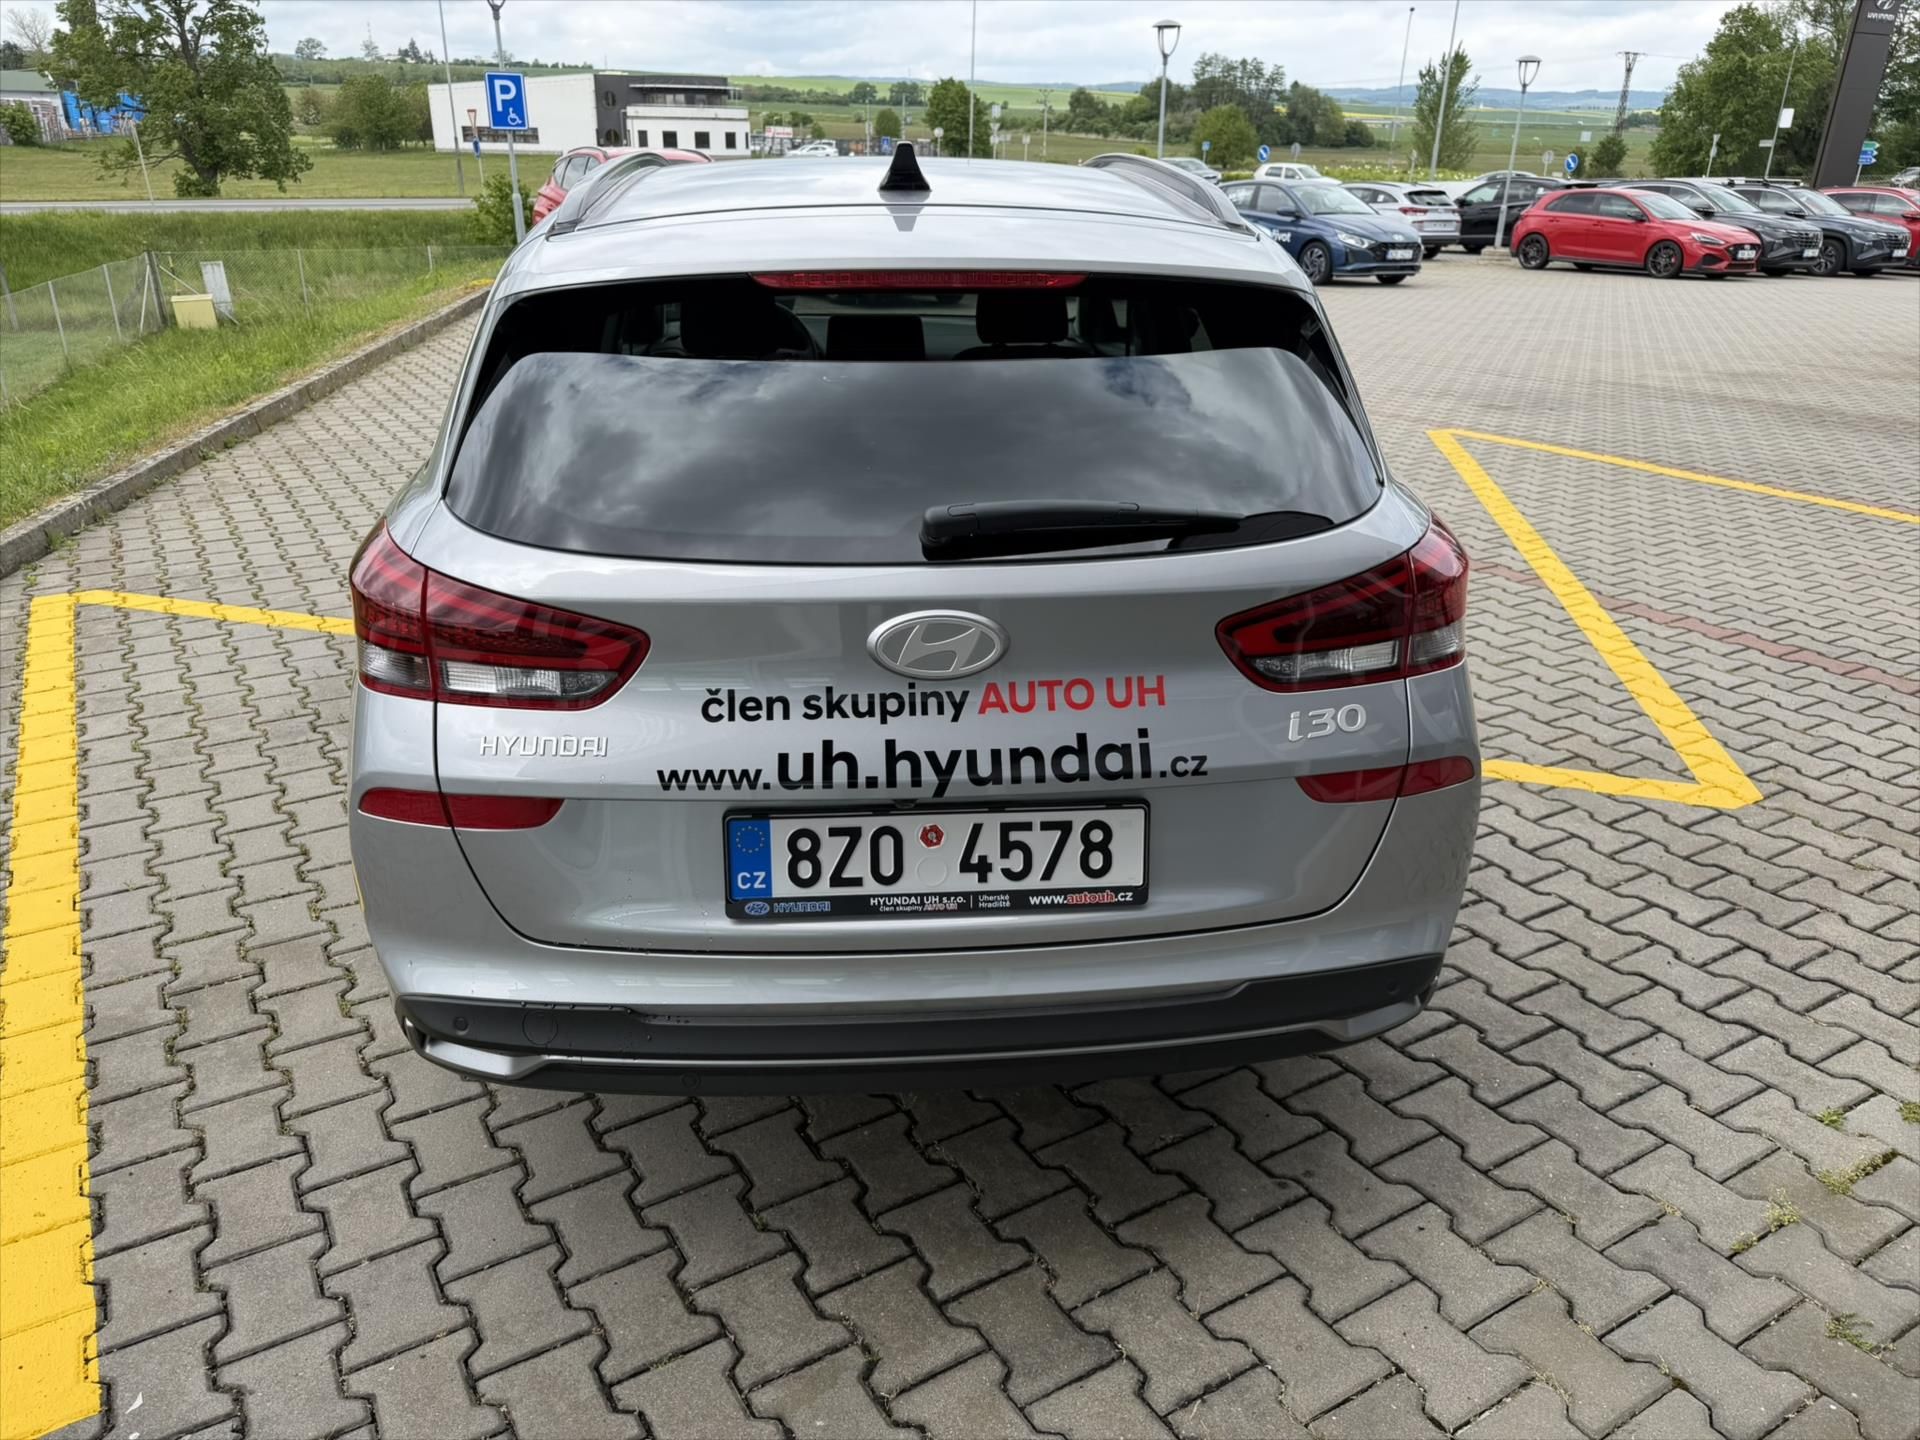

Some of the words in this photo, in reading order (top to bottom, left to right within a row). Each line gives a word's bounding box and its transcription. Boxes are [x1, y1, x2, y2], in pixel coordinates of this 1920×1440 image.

[494, 79, 517, 112] P
[701, 688, 790, 724] člen
[802, 682, 970, 724] skupiny
[977, 678, 1096, 714] AUTO
[1105, 675, 1166, 709] UH
[1288, 703, 1368, 742] i30
[479, 735, 609, 758] HYUNDAI
[657, 728, 1208, 798] www.uh.hyundai.cz
[787, 825, 903, 889] 8Z0
[958, 819, 1114, 884] 4578
[737, 871, 767, 890] CZ
[773, 901, 832, 913] HYUNDAI
[870, 896, 921, 906] HYUNDAI
[923, 895, 940, 904] UH
[942, 895, 967, 904] s.r.o.
[978, 894, 1010, 902] Uherské
[1029, 889, 1134, 905] www.autouh.cz
